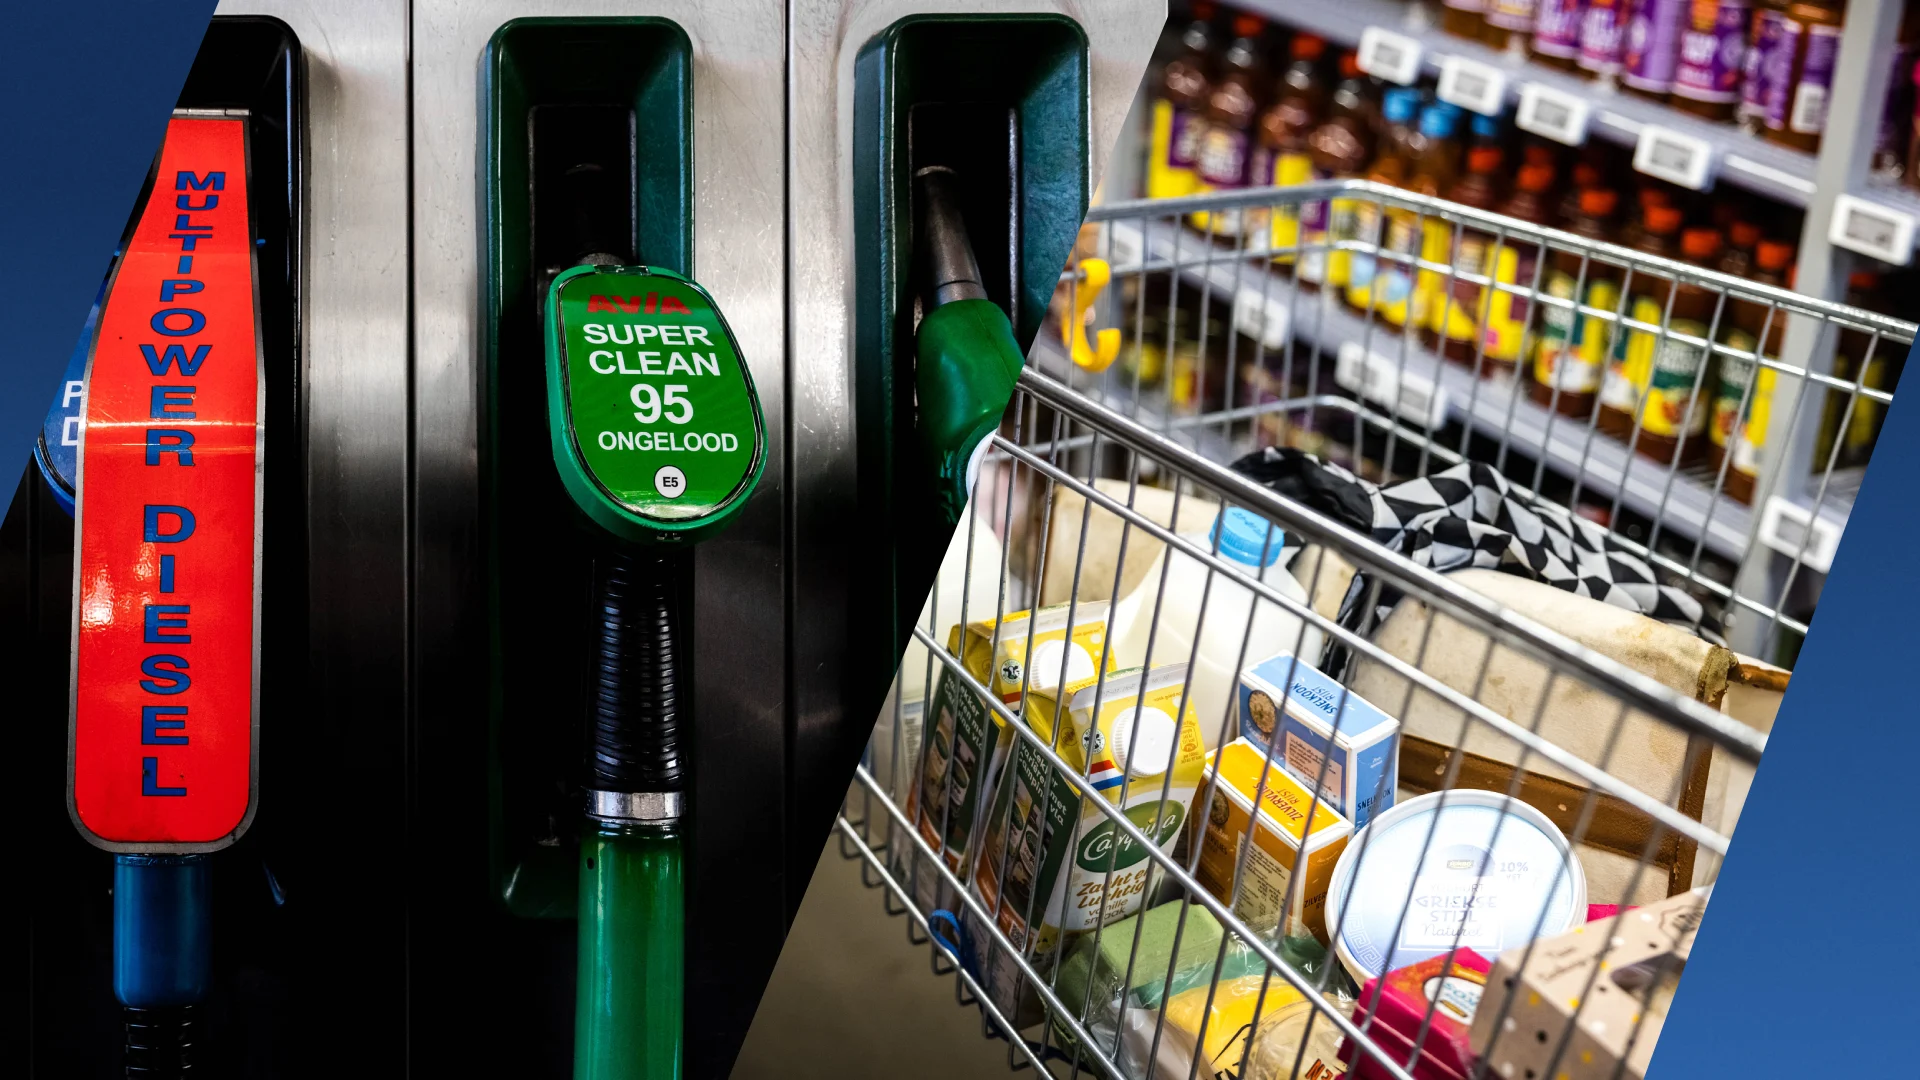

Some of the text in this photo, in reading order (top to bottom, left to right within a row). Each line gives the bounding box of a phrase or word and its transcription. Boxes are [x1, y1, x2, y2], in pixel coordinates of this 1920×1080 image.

[586, 291, 693, 315] AVIA
[583, 323, 715, 346] SUPER
[588, 350, 721, 376] CLEAN
[629, 383, 694, 424] 95
[597, 431, 739, 452] ONGELOOD
[139, 171, 226, 797] MULTIPOWER DIESEL
[662, 476, 679, 487] E5
[959, 685, 980, 717] ekker
[1415, 896, 1497, 909] GRIEKSE
[1430, 910, 1477, 923] STIJL
